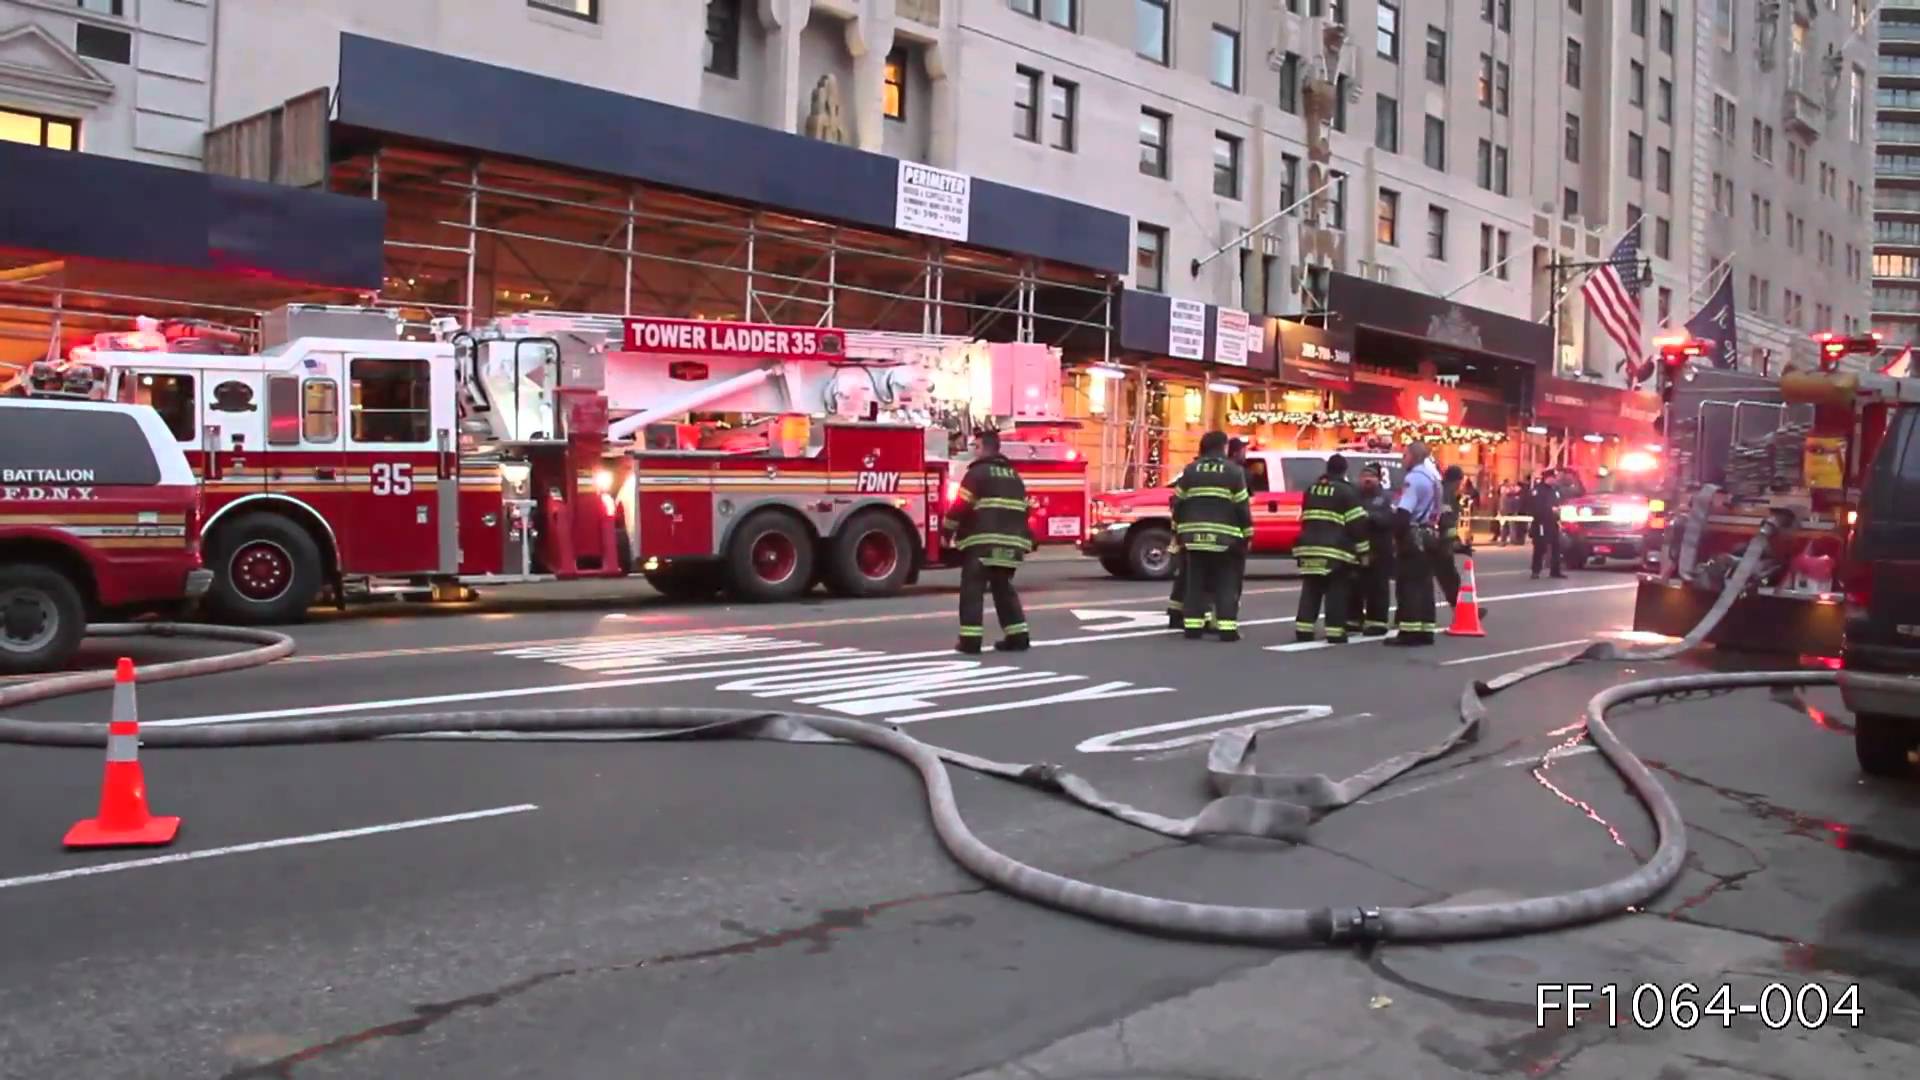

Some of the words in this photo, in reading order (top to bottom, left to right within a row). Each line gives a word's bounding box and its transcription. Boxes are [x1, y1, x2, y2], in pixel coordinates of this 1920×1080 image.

[904, 166, 965, 194] PERIMETER
[631, 323, 706, 349] TOWER
[711, 327, 790, 354] LADDER
[792, 332, 816, 354] 35
[3, 469, 94, 481] BATTALION
[372, 463, 411, 496] 35
[858, 471, 899, 492] FDNY
[1380, 467, 1391, 489] 3
[4, 487, 98, 500] F.D.N.Y.
